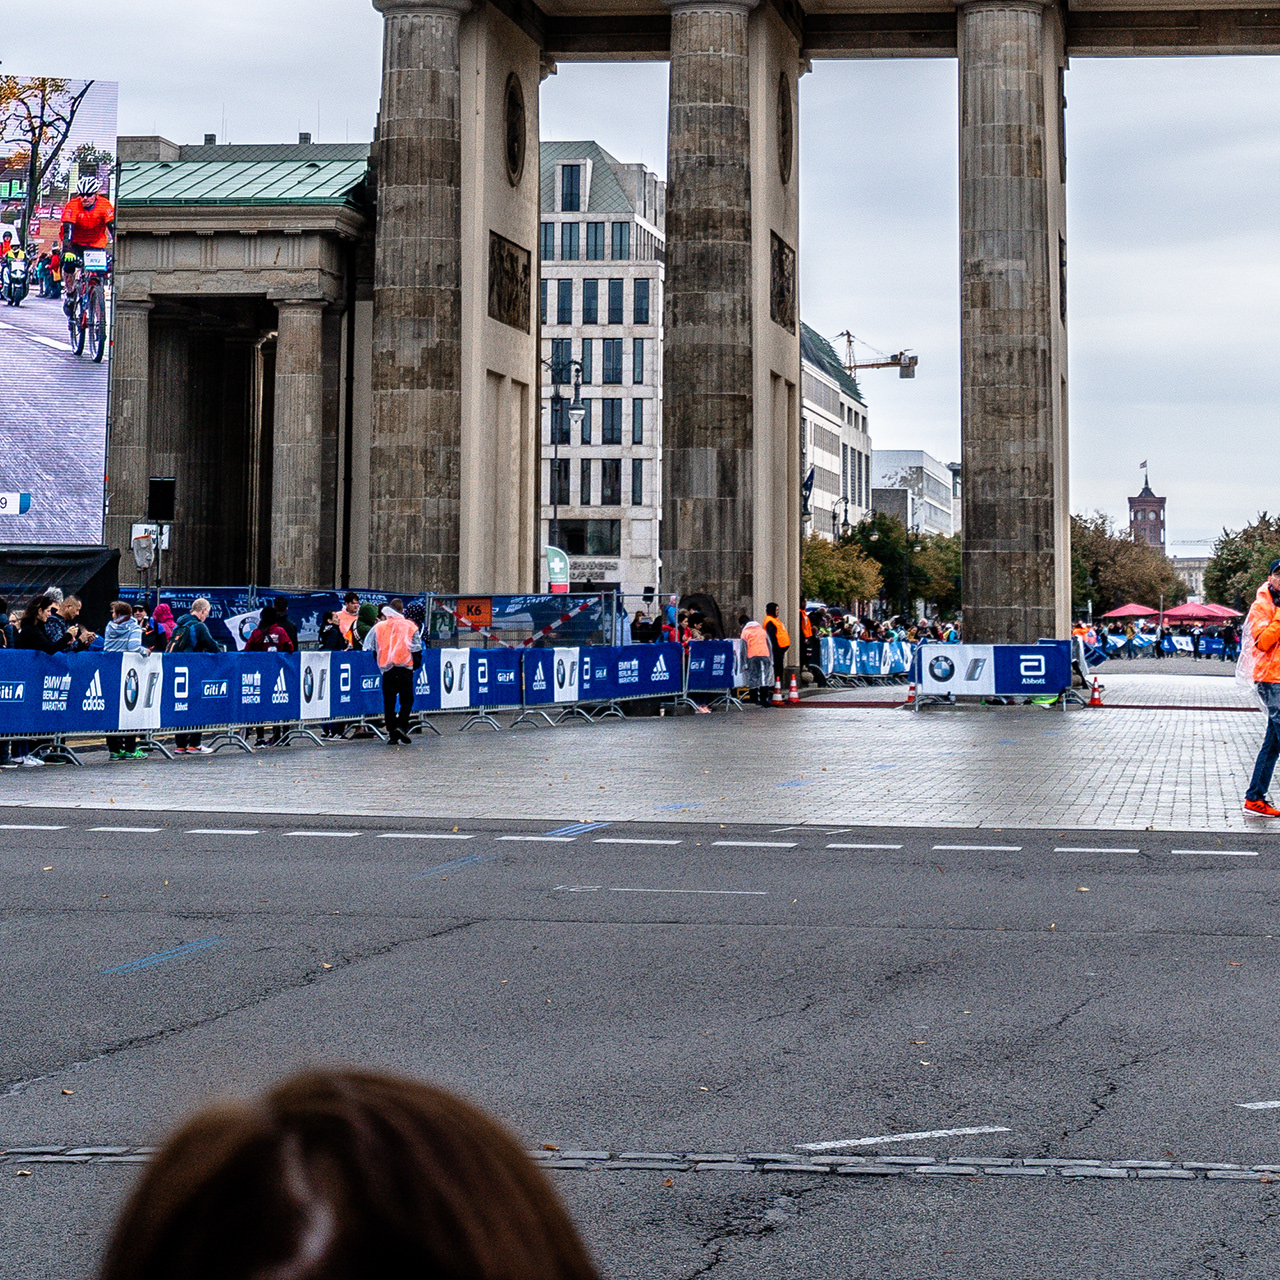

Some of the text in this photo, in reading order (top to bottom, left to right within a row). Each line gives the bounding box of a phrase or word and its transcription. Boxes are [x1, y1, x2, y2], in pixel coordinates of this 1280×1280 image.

[569, 560, 618, 571] RBUCKS
[570, 571, 605, 580] OFFEE
[466, 605, 482, 616] K6
[43, 675, 62, 689] BMW
[1021, 677, 1046, 685] Abbott
[42, 690, 59, 700] BERLIN
[203, 683, 219, 696] Giti
[41, 701, 67, 711] MARATHON
[82, 696, 105, 711] adidas
